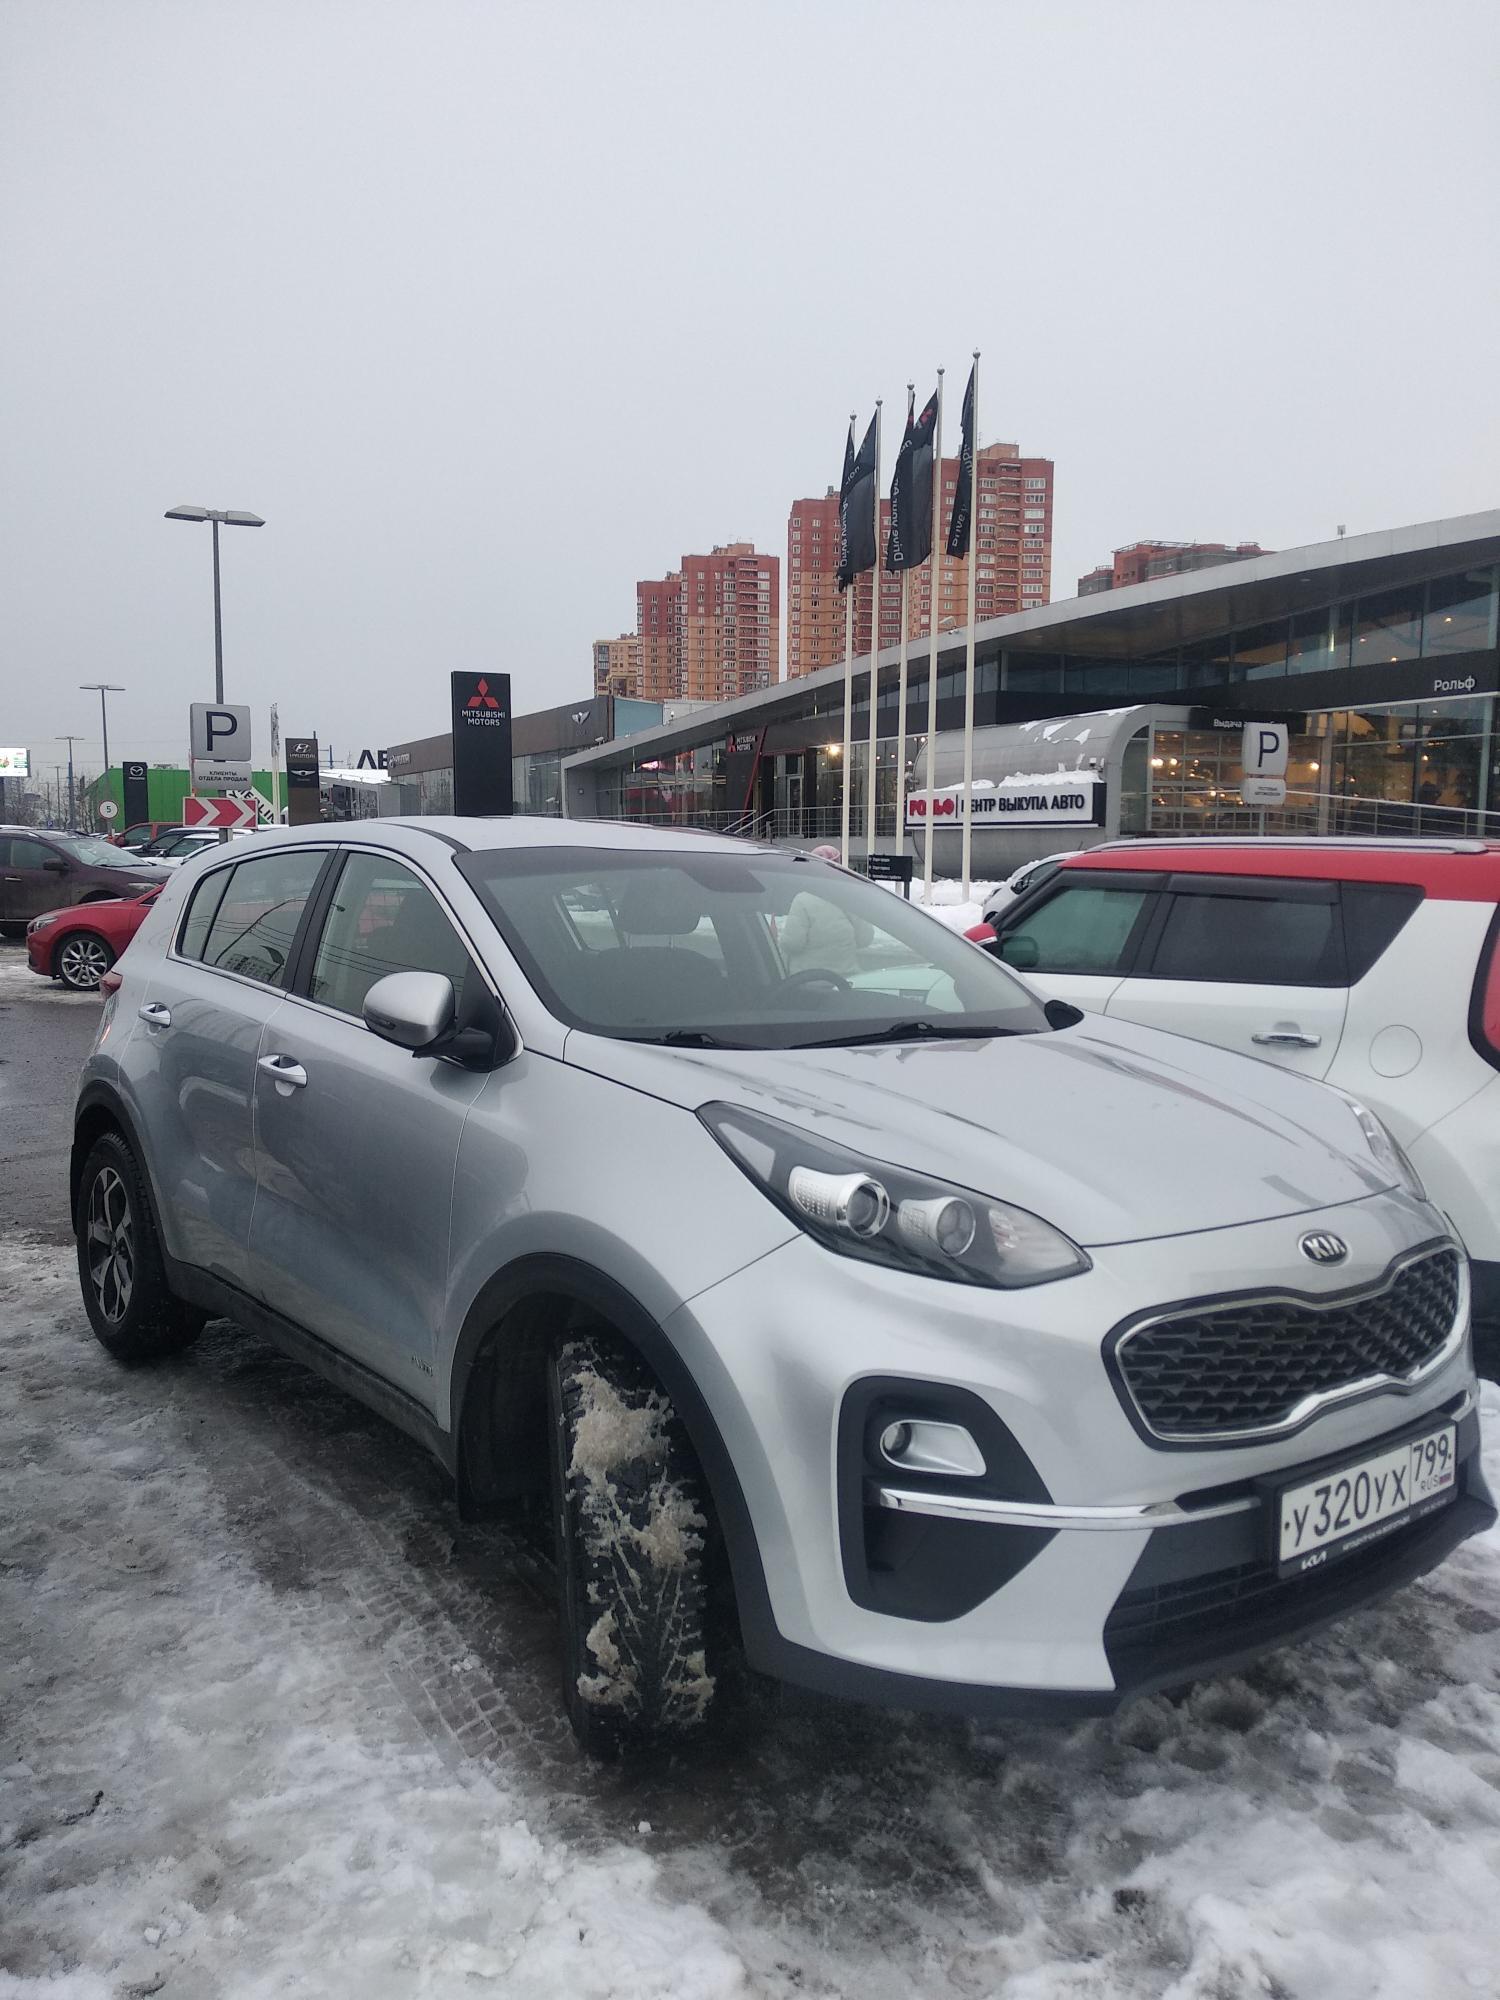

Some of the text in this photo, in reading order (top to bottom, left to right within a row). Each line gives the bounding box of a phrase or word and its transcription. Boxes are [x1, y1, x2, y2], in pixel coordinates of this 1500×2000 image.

[1433, 675, 1476, 691] Рольф
[461, 710, 506, 718] MITSUBISHI
[467, 718, 500, 726] MOTORS
[106, 805, 112, 813] 5
[999, 797, 1048, 812] ВЫКУПА
[1050, 794, 1085, 810] АВТО
[1304, 1235, 1346, 1259] KIA
[1413, 1433, 1449, 1482] 799
[1420, 1475, 1440, 1491] RUS
